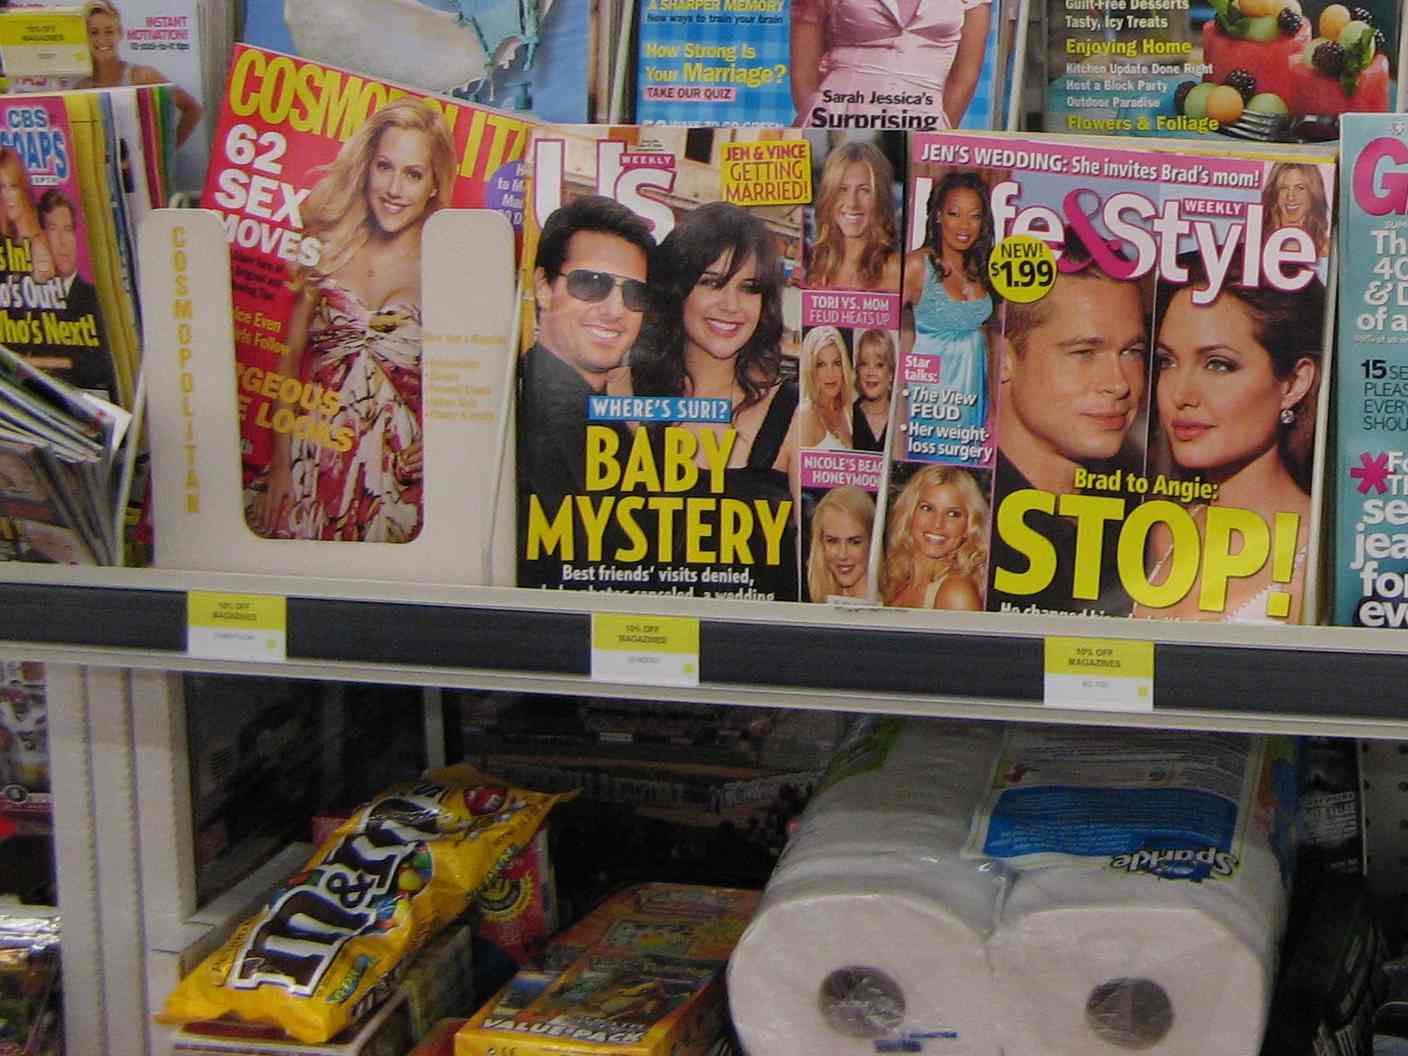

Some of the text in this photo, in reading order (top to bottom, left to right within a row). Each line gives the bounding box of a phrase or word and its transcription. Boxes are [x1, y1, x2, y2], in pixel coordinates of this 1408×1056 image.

[8, 109, 47, 128] CBS
[225, 124, 287, 175] 62
[622, 154, 673, 166] WEEKLY
[731, 162, 803, 180] GETTING
[921, 145, 1260, 186] JEN'S WEDDING: She invites Brad's mom!
[215, 169, 311, 228] SEX
[725, 182, 808, 201] MARRIED!
[1183, 200, 1243, 215] WEEKLY
[1000, 243, 1044, 259] NEW!
[991, 261, 1053, 288] $1.99
[45, 315, 98, 346] Next!
[1357, 310, 1387, 332] of
[593, 398, 727, 419] WHERE'S SURI?
[585, 427, 736, 493] BABY
[1075, 468, 1219, 500] Brad to Angie:
[526, 496, 792, 564] MYSTERY
[994, 489, 1299, 617] STOP!
